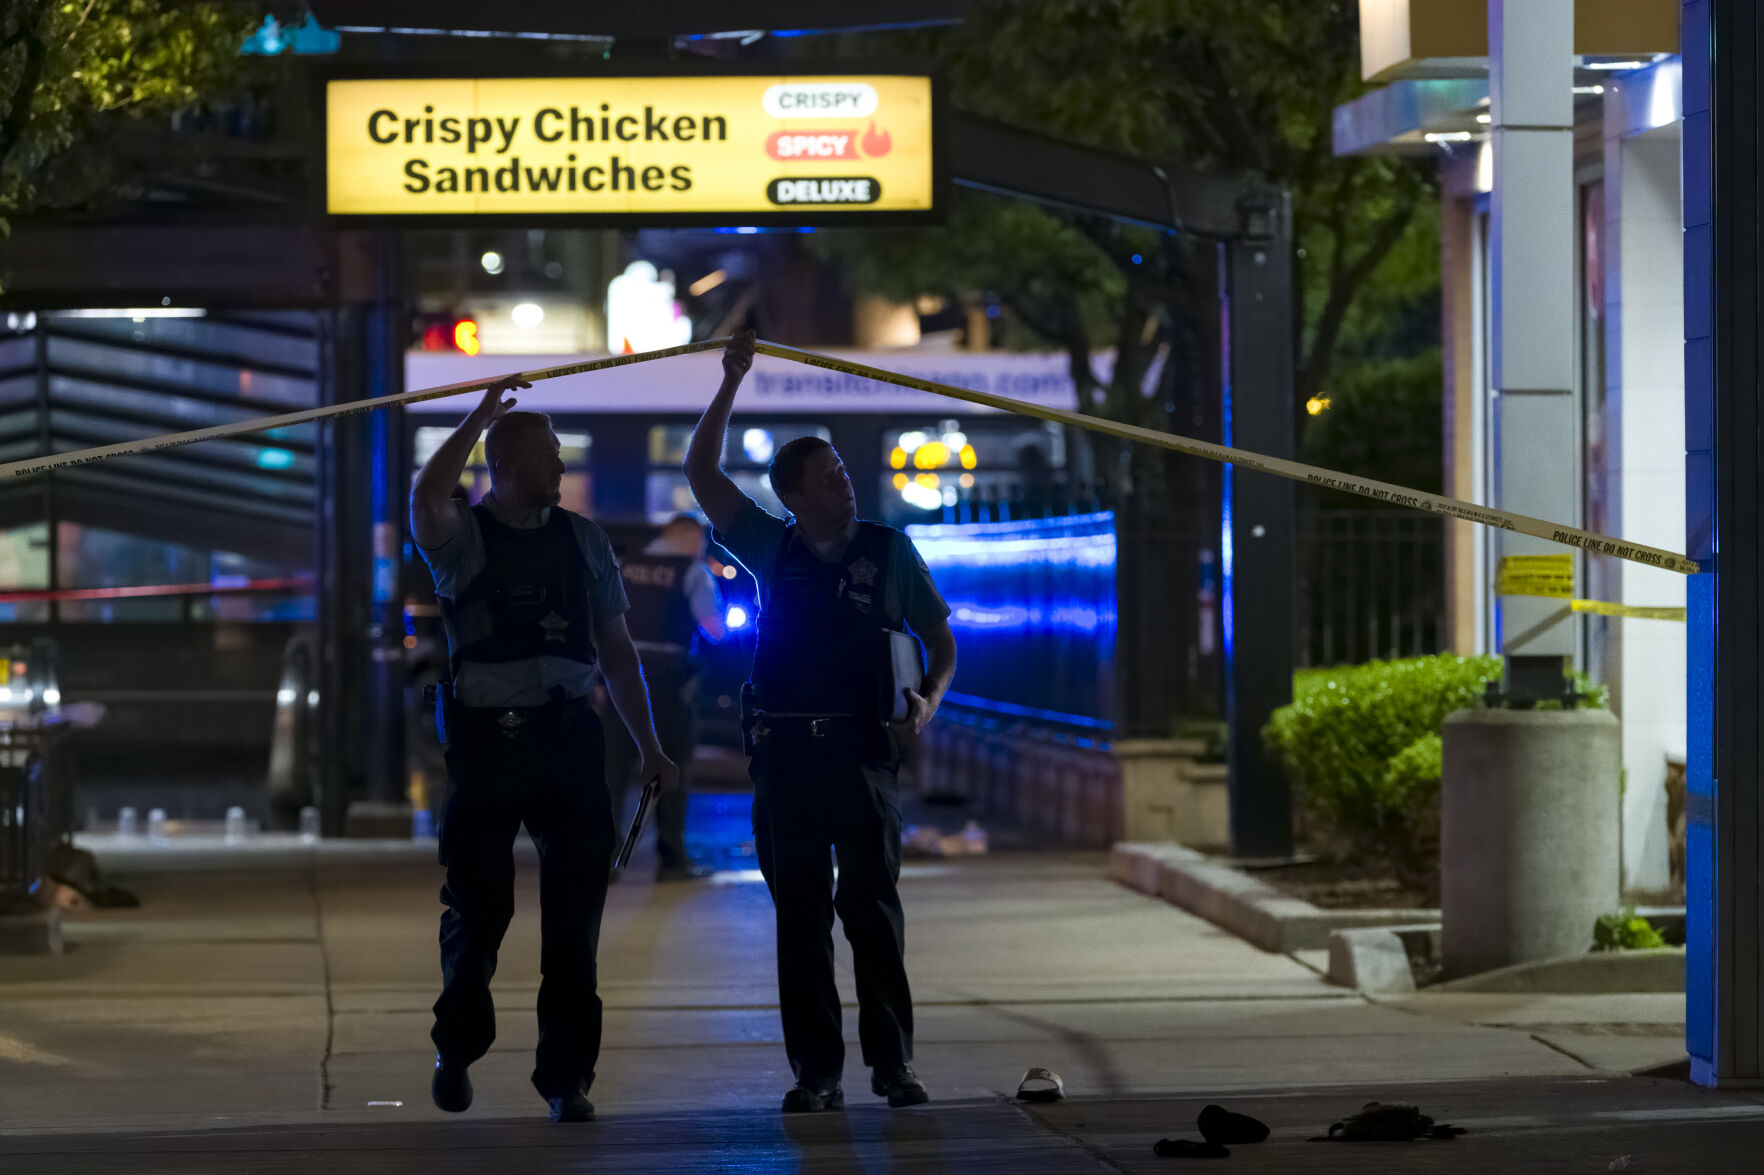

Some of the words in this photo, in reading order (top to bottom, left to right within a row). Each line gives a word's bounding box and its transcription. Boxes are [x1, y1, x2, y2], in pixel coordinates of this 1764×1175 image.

[778, 91, 863, 109] CRISPY
[368, 104, 520, 154] Crispy
[534, 103, 727, 143] Chicken
[776, 134, 849, 157] SPICY
[404, 153, 693, 193] Sandwiches
[776, 179, 871, 202] DELUXE
[1391, 492, 1418, 506] CROSS
[1552, 530, 1583, 546] POLICE
[1583, 537, 1603, 550] LINE
[1603, 543, 1615, 554] DO
[1618, 545, 1635, 557] NOT
[1635, 550, 1663, 565] CROSS
